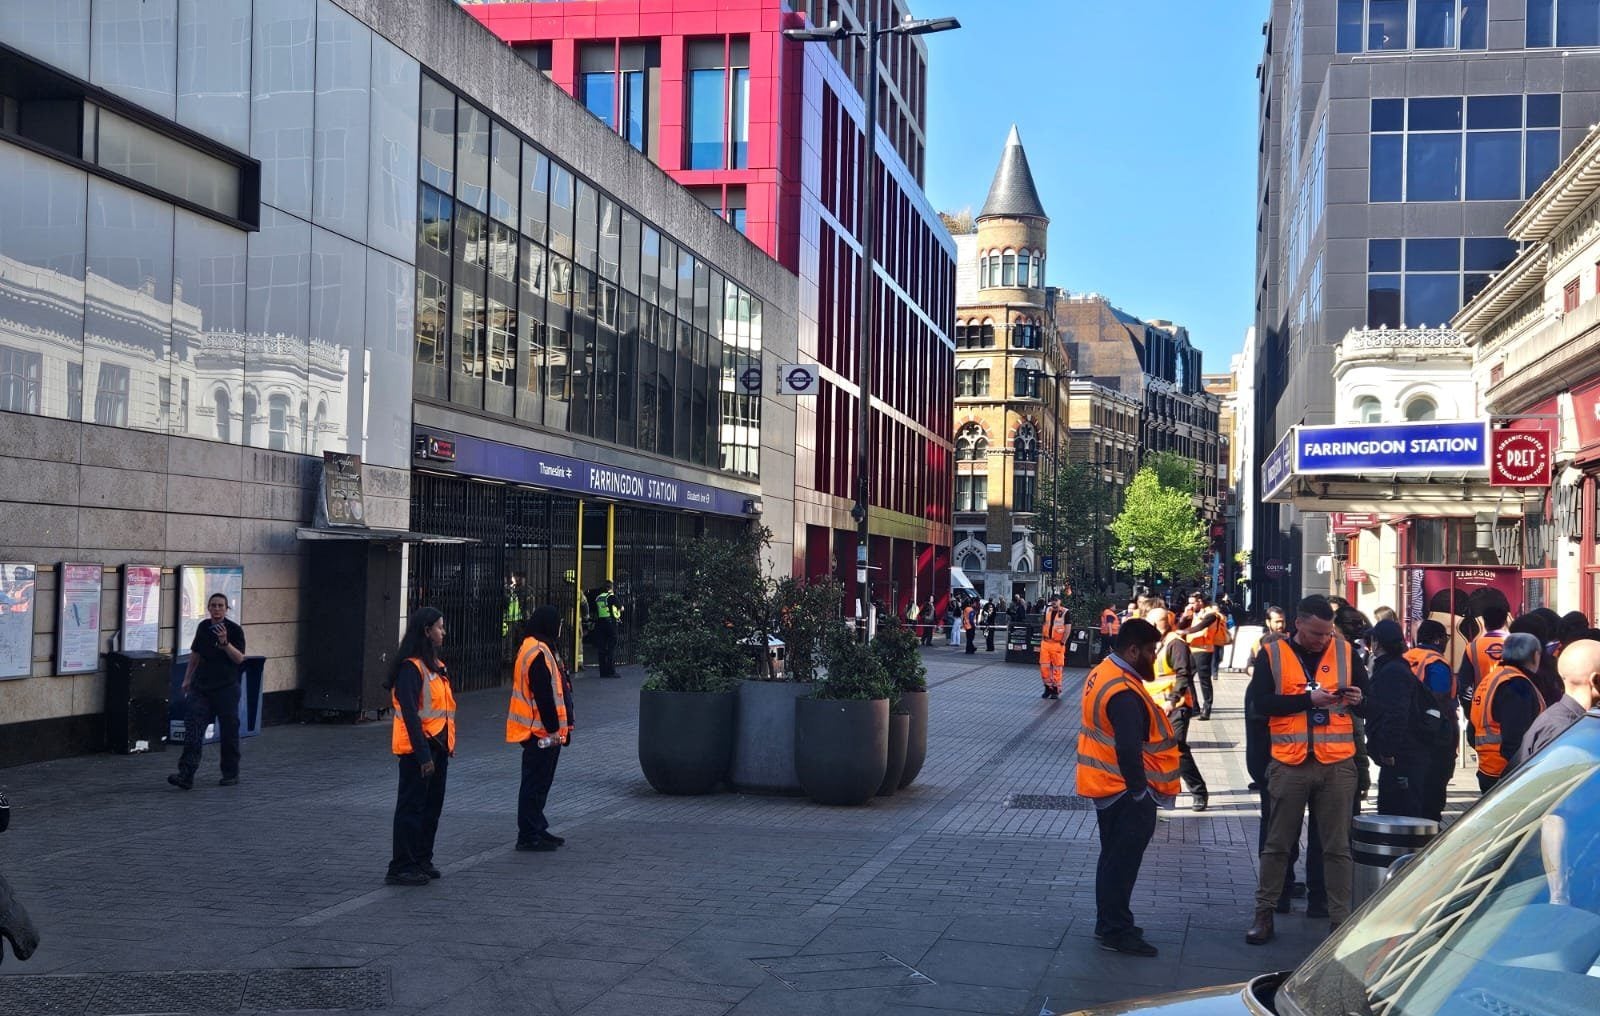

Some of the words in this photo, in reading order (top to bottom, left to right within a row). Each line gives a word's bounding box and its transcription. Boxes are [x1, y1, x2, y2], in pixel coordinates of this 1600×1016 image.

[1304, 440, 1406, 457] FARRINGDON
[1410, 437, 1478, 453] STATION
[1498, 434, 1522, 450] ORGANIC
[1524, 435, 1543, 450] COFFEE
[1506, 449, 1536, 467] PRET
[539, 462, 565, 477] Thameslink
[590, 467, 644, 497] FARRINGDON
[648, 479, 678, 503] STATION
[1455, 570, 1496, 578] TIMPSON
